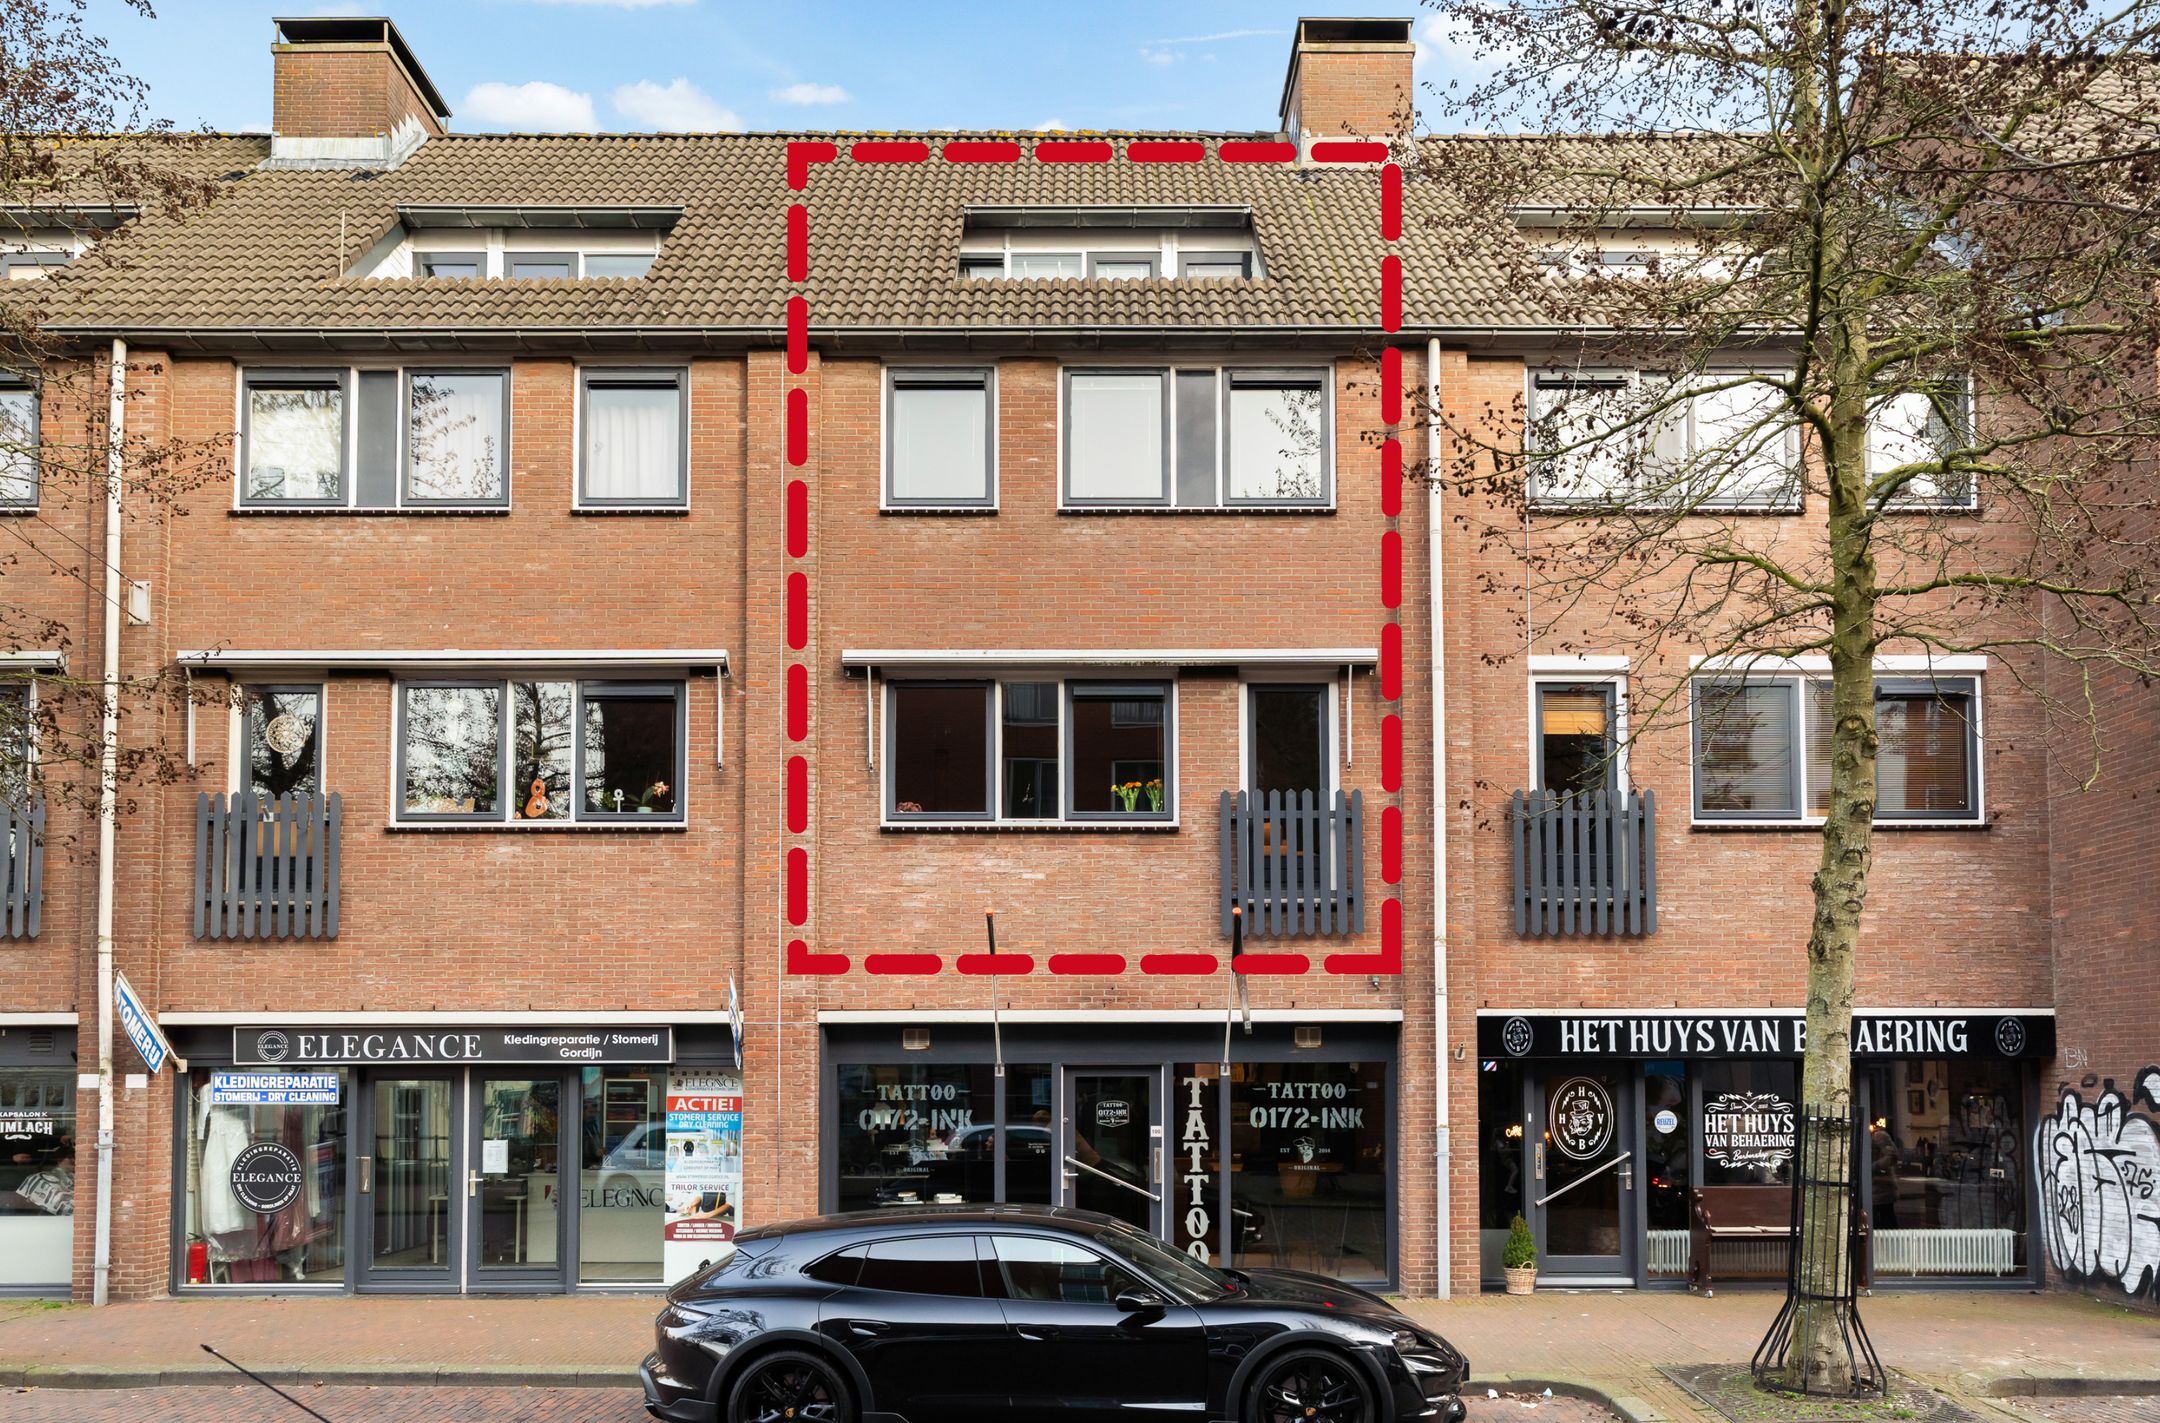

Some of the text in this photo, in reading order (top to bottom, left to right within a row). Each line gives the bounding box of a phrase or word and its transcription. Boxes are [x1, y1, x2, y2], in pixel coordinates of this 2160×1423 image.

[115, 986, 161, 1065] STOMERIJ
[504, 1034, 600, 1047] Kledingreparatie
[612, 1034, 659, 1046] Stomerij
[1561, 1019, 1623, 1053] HET
[1629, 1019, 1715, 1053] HUYS
[1720, 1019, 1780, 1053] VAN
[1793, 1019, 1967, 1053] BAERING
[297, 1034, 483, 1059] ELEGANCE
[560, 1047, 602, 1060] Gordijn
[214, 1076, 336, 1089] KLEDINGREPARATIE
[214, 1092, 260, 1102] STOMERIJ
[268, 1092, 287, 1102] DRY
[288, 1092, 336, 1102] CLEANING
[877, 1084, 956, 1101] TATTOO
[1268, 1082, 1346, 1099] TATTOO
[1578, 1086, 1585, 1097] H
[674, 1098, 734, 1111] ACTIE!
[669, 1113, 739, 1121] STOMERIJ SERVICE
[859, 1109, 973, 1130] 0172-INK
[1250, 1106, 1365, 1129] 0172-INK
[1558, 1113, 1566, 1124] H
[1597, 1113, 1604, 1125] V
[1705, 1113, 1795, 1134] HET HUYS
[678, 1120, 729, 1129] DRY CLEANING
[1579, 1139, 1586, 1150] B
[1705, 1135, 1795, 1147] VAN BEHAERING
[237, 1146, 297, 1171] KLEDINGREPARATIE
[232, 1172, 302, 1183] ELEGANCE
[671, 1183, 730, 1191] TAILOR SERVICE
